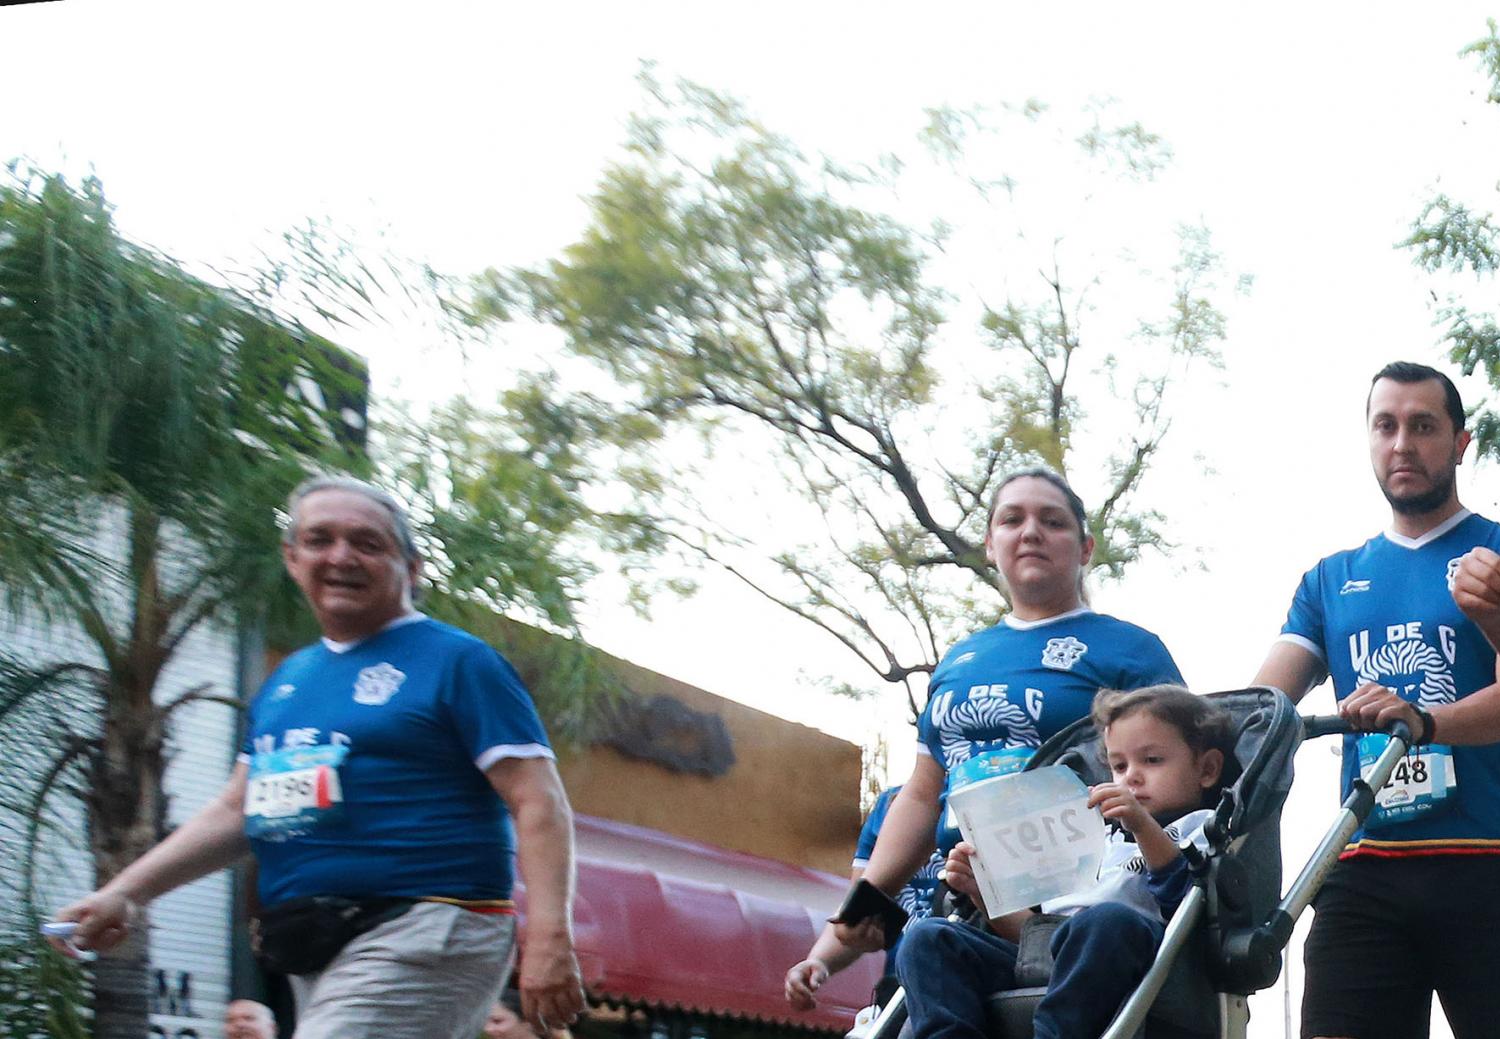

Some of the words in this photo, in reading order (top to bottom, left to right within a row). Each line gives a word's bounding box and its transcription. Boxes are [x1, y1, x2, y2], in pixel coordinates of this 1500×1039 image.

[1349, 629, 1369, 672] U
[1386, 621, 1423, 642] DE
[1438, 624, 1456, 665] G
[968, 684, 1008, 700] DE
[1024, 687, 1044, 721] G
